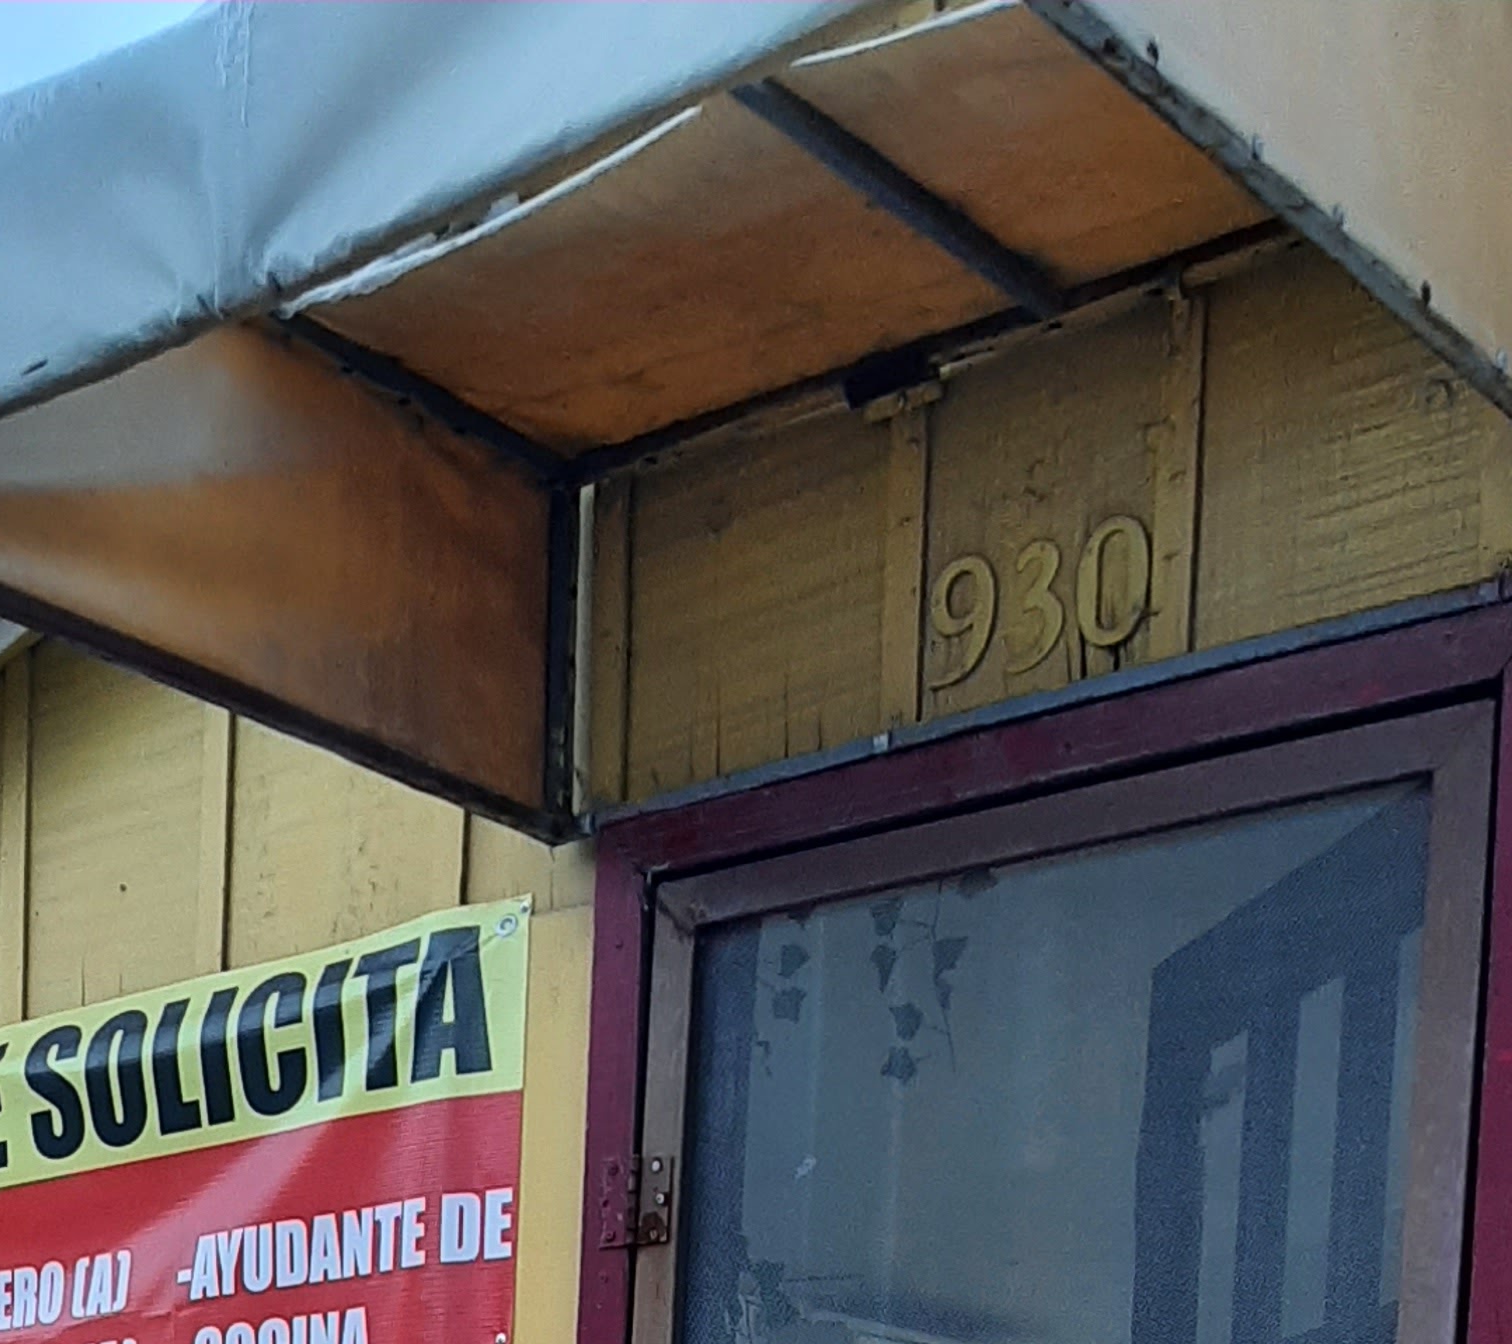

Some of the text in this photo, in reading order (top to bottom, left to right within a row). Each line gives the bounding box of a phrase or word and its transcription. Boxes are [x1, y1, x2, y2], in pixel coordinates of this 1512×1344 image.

[929, 515, 1151, 690] 930
[24, 925, 493, 1160] SOLICITA
[177, 1187, 514, 1302] -AYUDANTE DE
